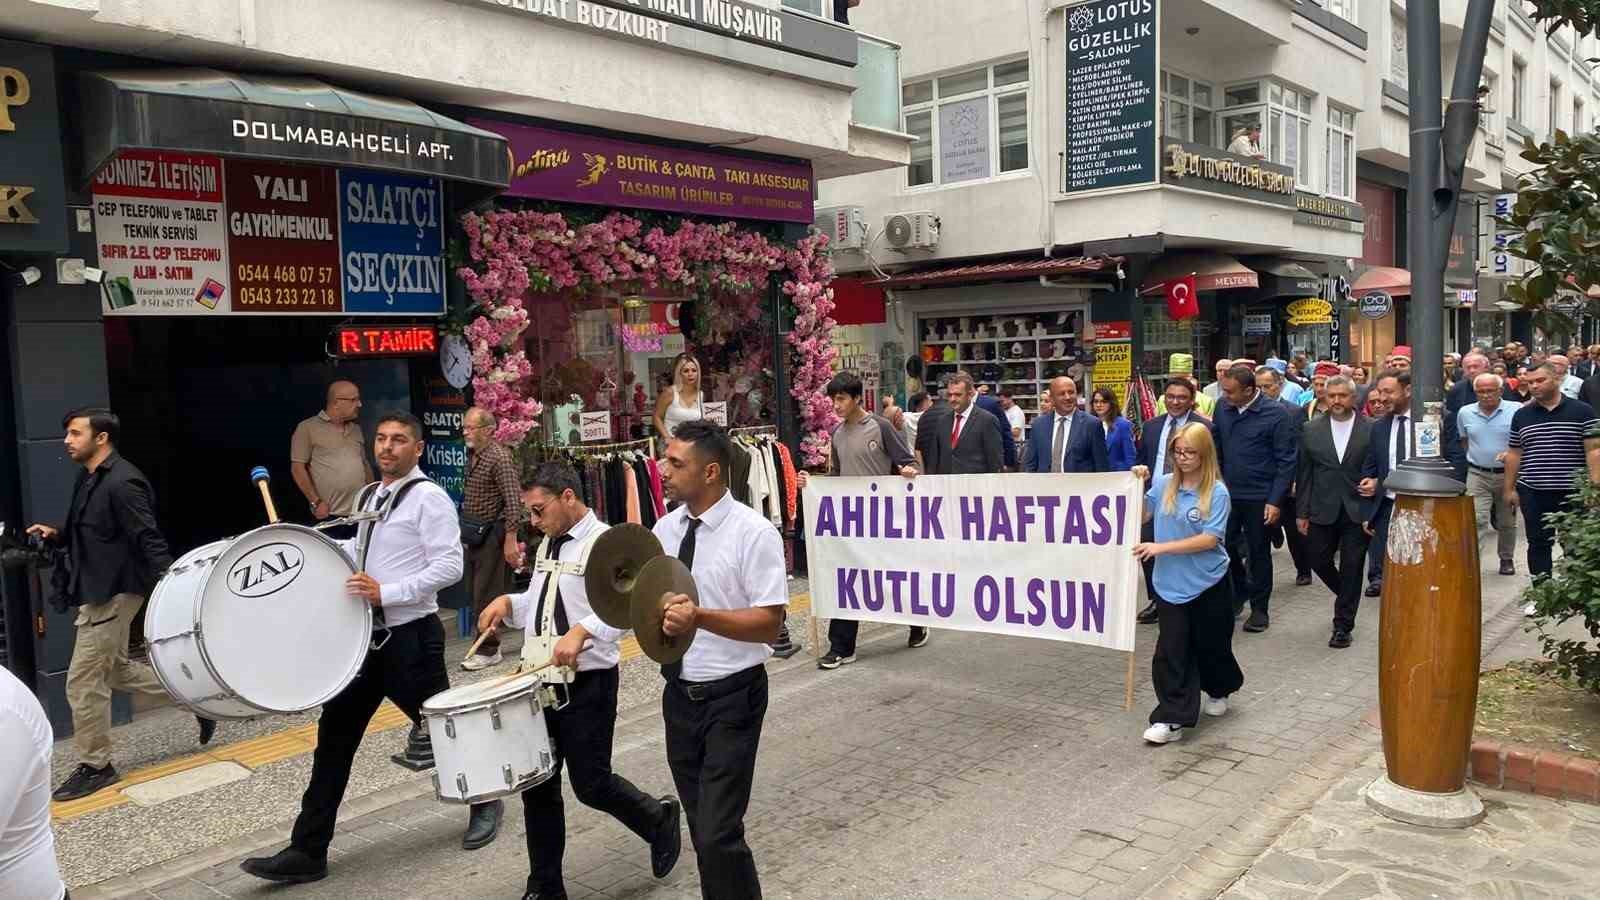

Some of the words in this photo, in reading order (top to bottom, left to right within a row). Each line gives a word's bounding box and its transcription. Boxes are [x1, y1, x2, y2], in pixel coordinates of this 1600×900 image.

[499, 0, 568, 19] DAT
[577, 2, 671, 42] BOZKURT
[703, 0, 782, 42] MÜŞAVİR
[1098, 0, 1152, 23] LOTUS
[1069, 22, 1152, 51] GÜZELLİK
[1088, 43, 1131, 60] SALONU
[232, 119, 410, 154] DOLMABAHÇELİ
[417, 141, 454, 161] APT.
[159, 154, 216, 199] İLETİŞİM
[617, 154, 658, 174] BUTİK
[661, 160, 672, 175] &
[675, 162, 716, 182] ÇANTA
[724, 168, 750, 185] TAKI
[752, 173, 809, 192] AKSESUAR
[253, 174, 308, 202] YALI
[618, 180, 676, 201] TASARIM
[680, 186, 734, 206] ÜRÜNLER
[98, 202, 117, 216] CEP
[120, 203, 169, 219] TELEFONU
[172, 209, 183, 220] ve
[184, 207, 218, 222] TABLET
[347, 178, 438, 238] SAATÇİ
[123, 222, 160, 239] TEKNİK
[162, 224, 198, 241] SERVİSİ
[230, 208, 334, 241] GAYRİMENKUL
[101, 244, 128, 259] SIFIR
[130, 245, 151, 260] 2.EL
[153, 246, 172, 260] CEP
[174, 247, 221, 261] TELEFONU
[1495, 255, 1508, 273] LC
[133, 265, 157, 280] ALIM
[164, 266, 193, 280] SATIM
[238, 264, 269, 282] 0544
[274, 265, 296, 283] 468
[300, 266, 314, 284] 07
[319, 267, 333, 284] 57
[346, 243, 440, 305] SEÇKİN
[240, 287, 271, 305] 0543
[276, 288, 298, 305] 233
[302, 288, 316, 305] 22
[321, 288, 334, 305] 18
[341, 330, 360, 352] R
[363, 327, 436, 352] TAMİR
[815, 482, 945, 540] AHİLİK
[959, 494, 1128, 546] HAFTASI
[233, 551, 301, 592] ZAL
[836, 567, 956, 618] KUTLU
[973, 574, 1107, 634] OLSUN
